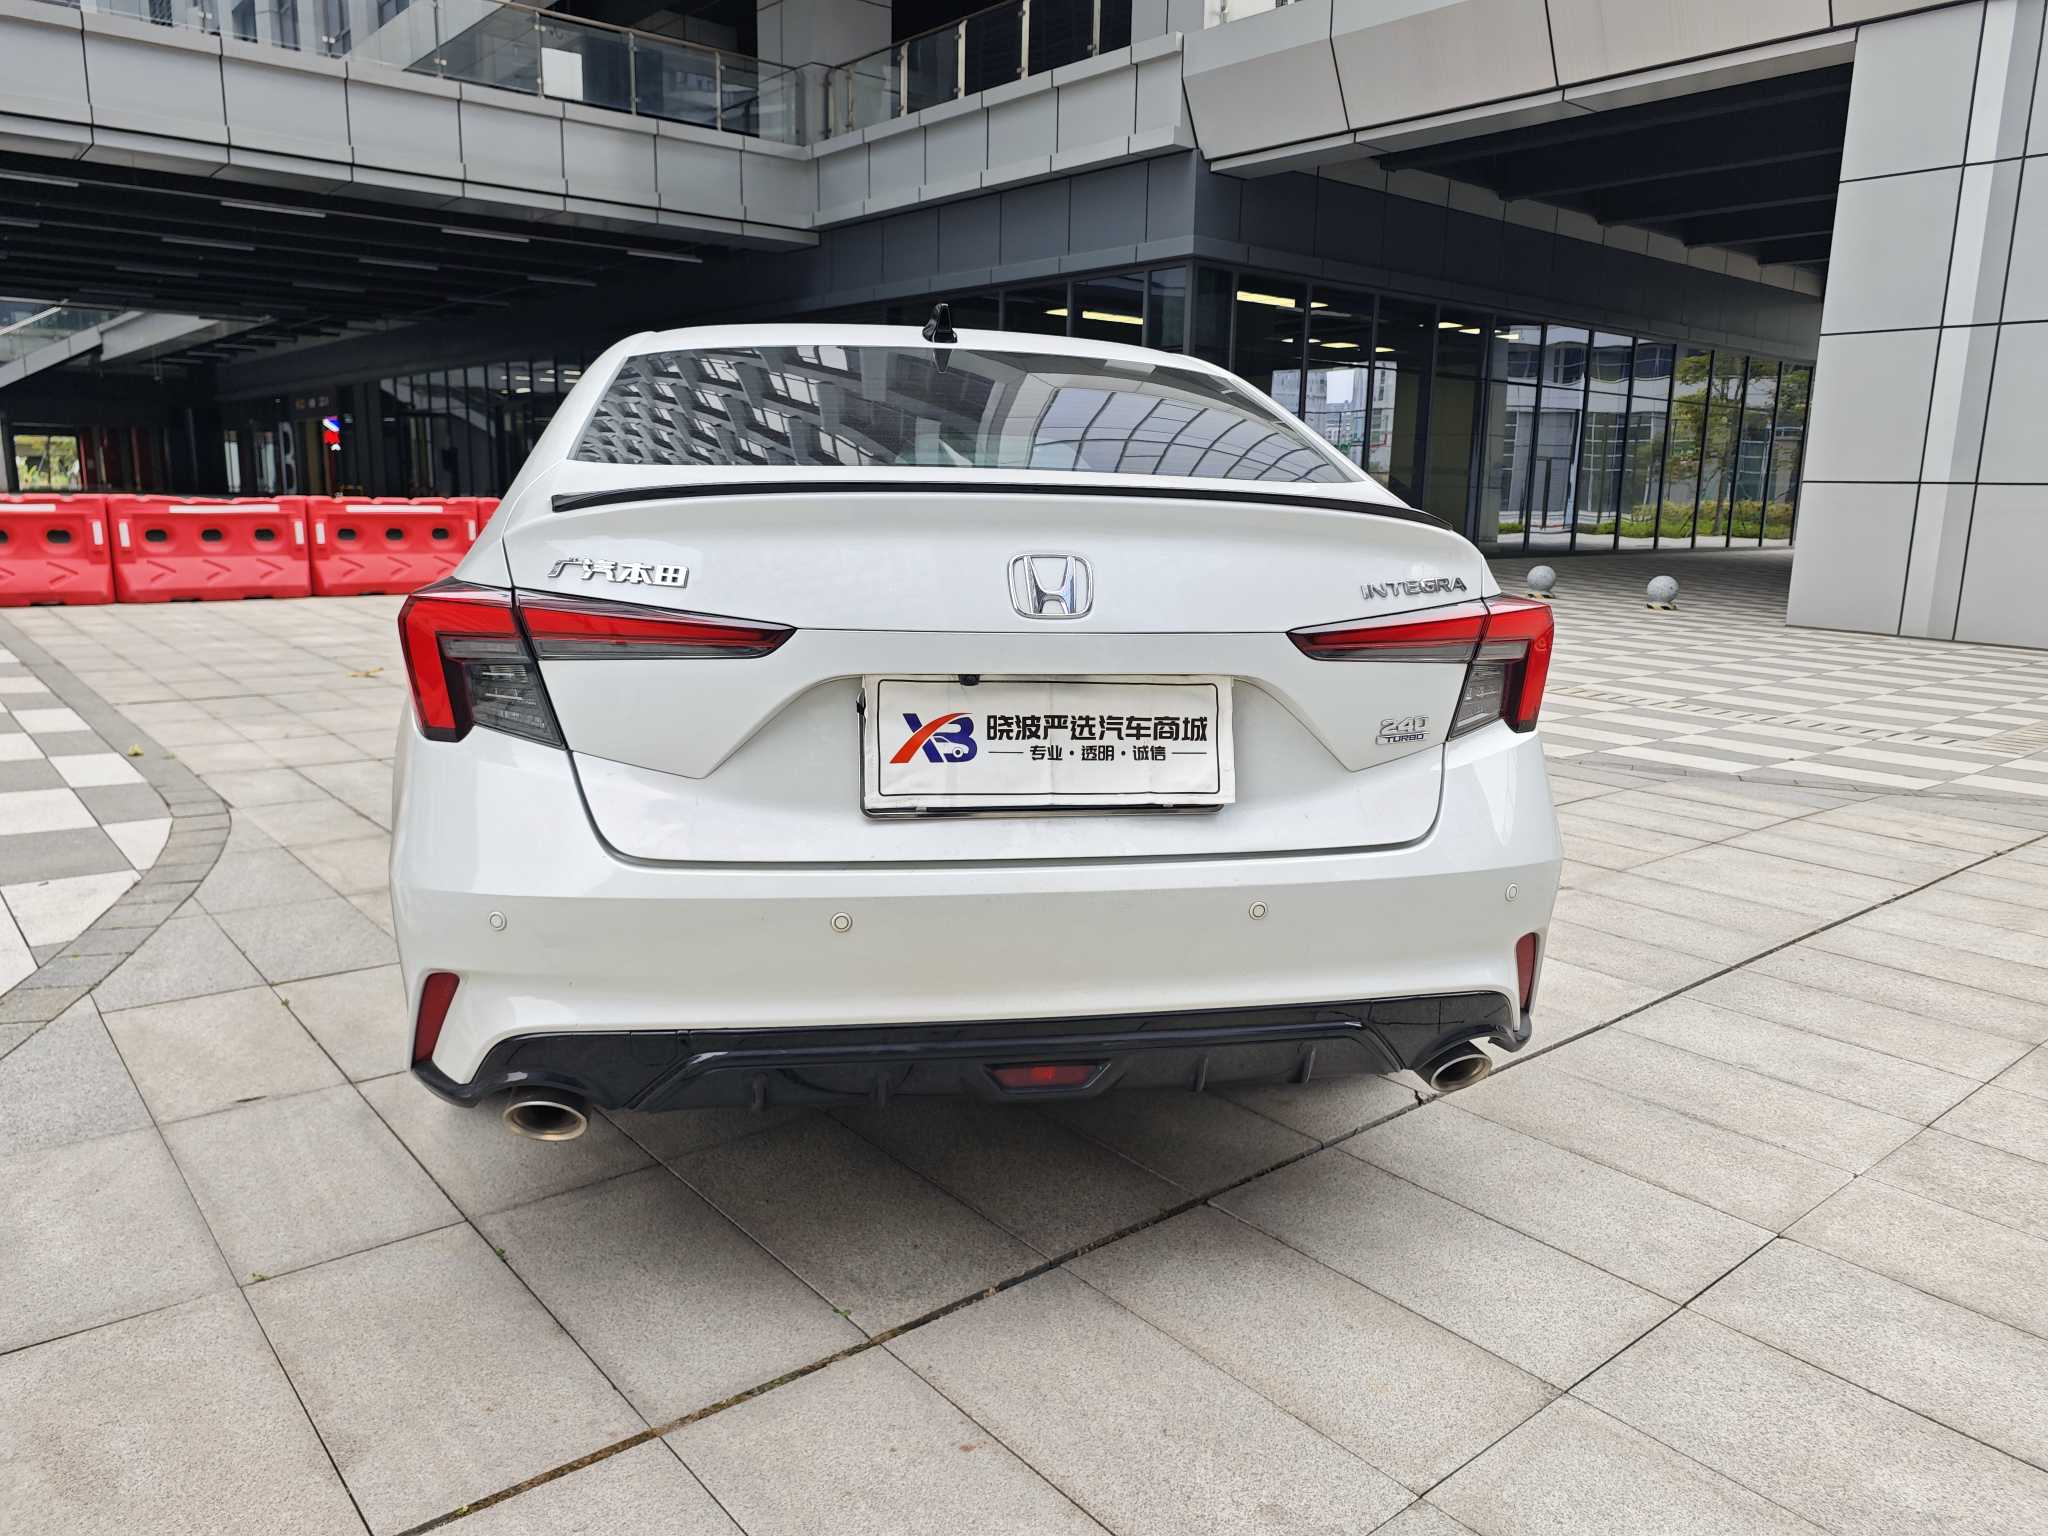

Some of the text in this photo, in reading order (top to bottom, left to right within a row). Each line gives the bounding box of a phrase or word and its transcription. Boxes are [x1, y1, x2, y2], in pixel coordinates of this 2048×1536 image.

[548, 555, 689, 588] 广汽本田
[1360, 577, 1467, 600] INTEGRA
[986, 714, 1208, 742] 晓波严选汽车商城
[1387, 733, 1424, 743] TURBO
